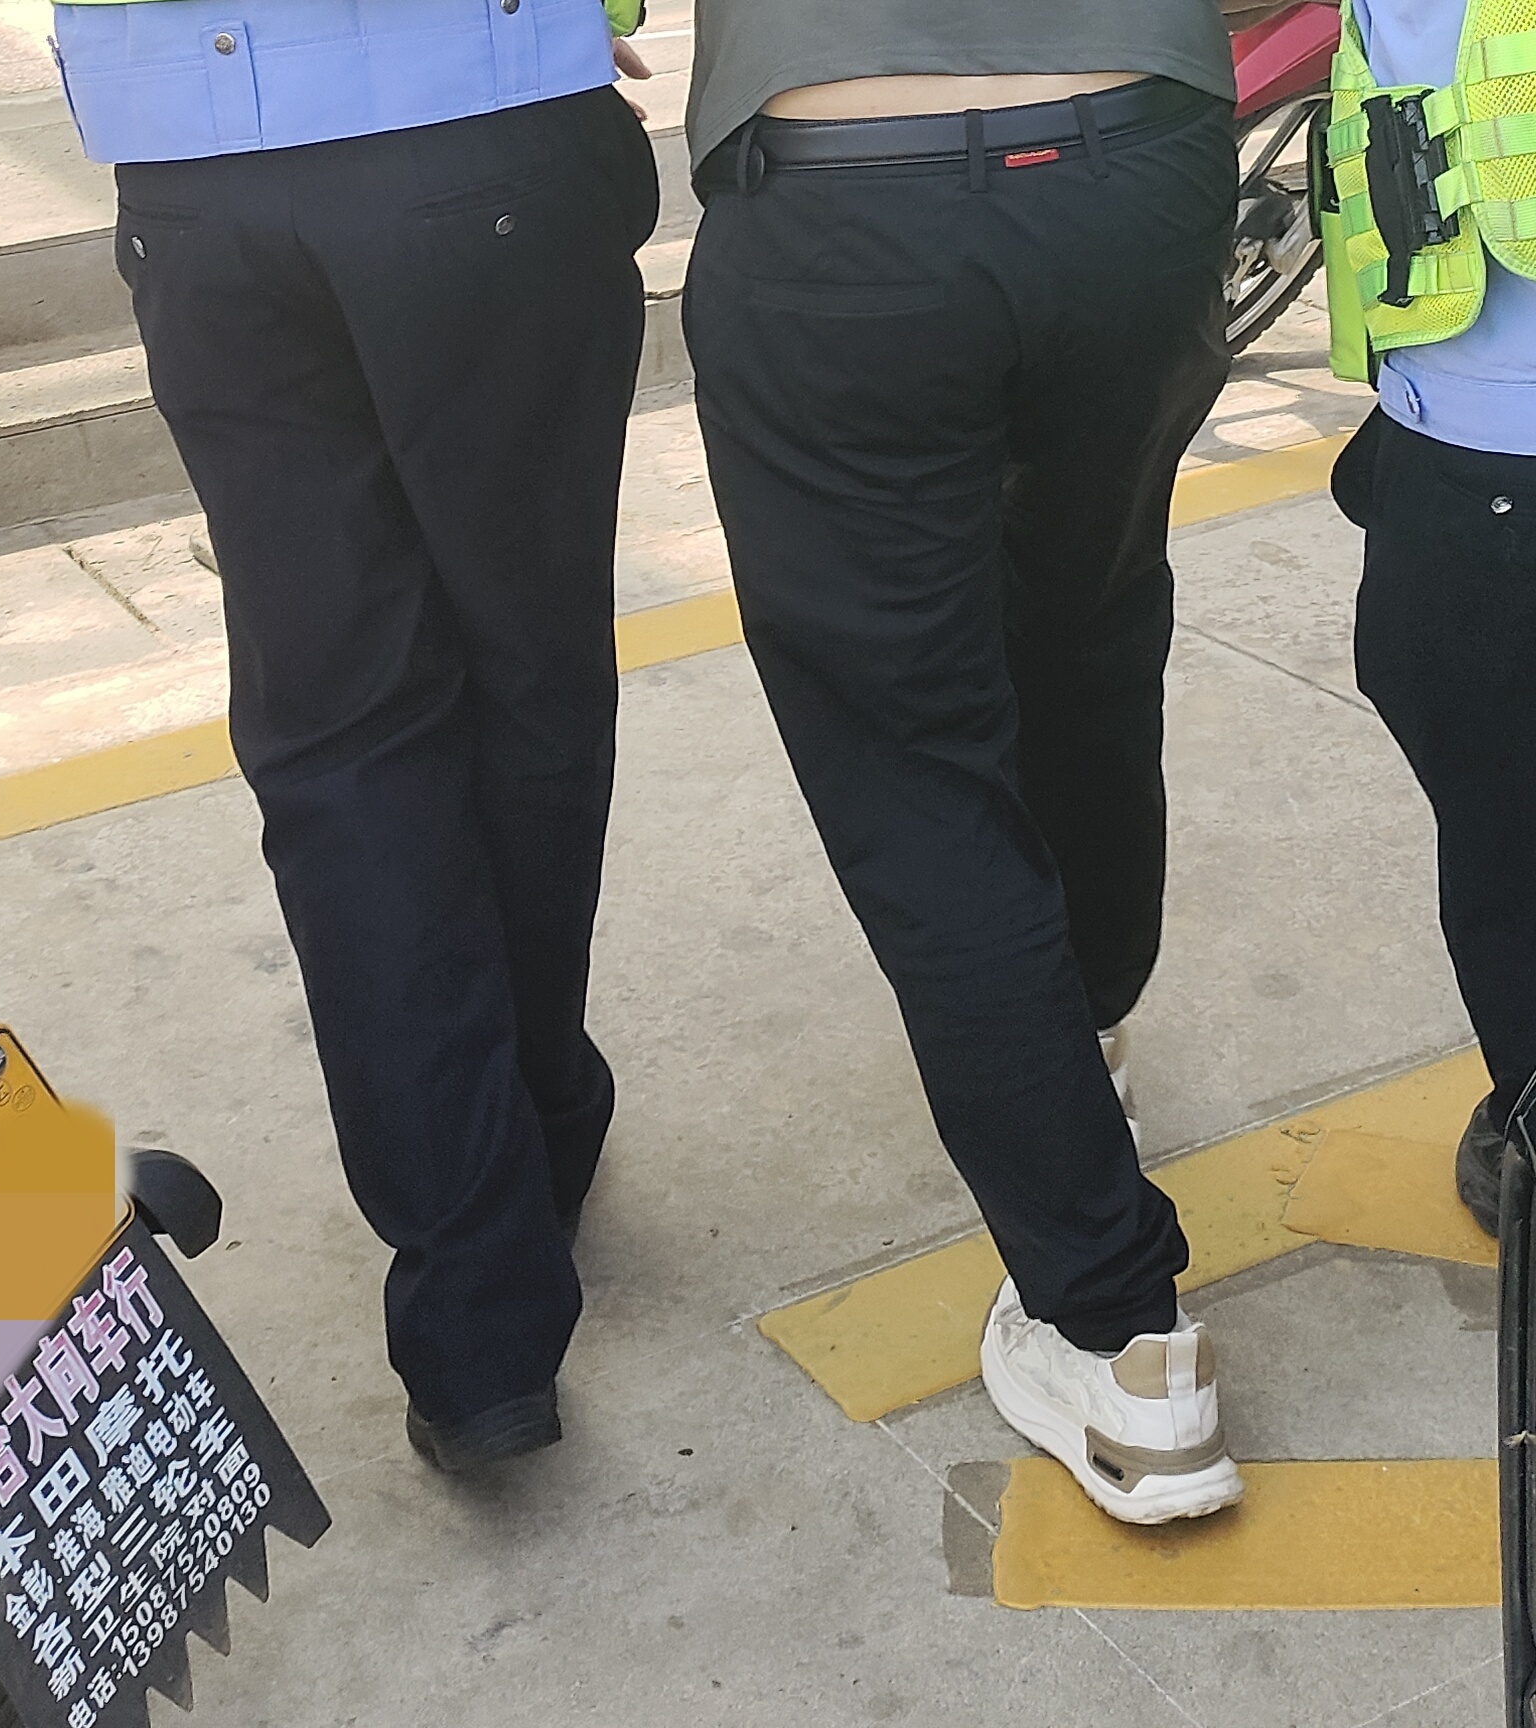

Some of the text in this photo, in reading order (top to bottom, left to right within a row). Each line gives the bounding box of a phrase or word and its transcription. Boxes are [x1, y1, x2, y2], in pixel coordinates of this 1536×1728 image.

[31, 1411, 237, 1669] 各型三轮车
[47, 1433, 252, 1702] 新卫生院对面
[112, 1462, 262, 1658] 15087520809
[122, 1482, 272, 1679] 13987540130
